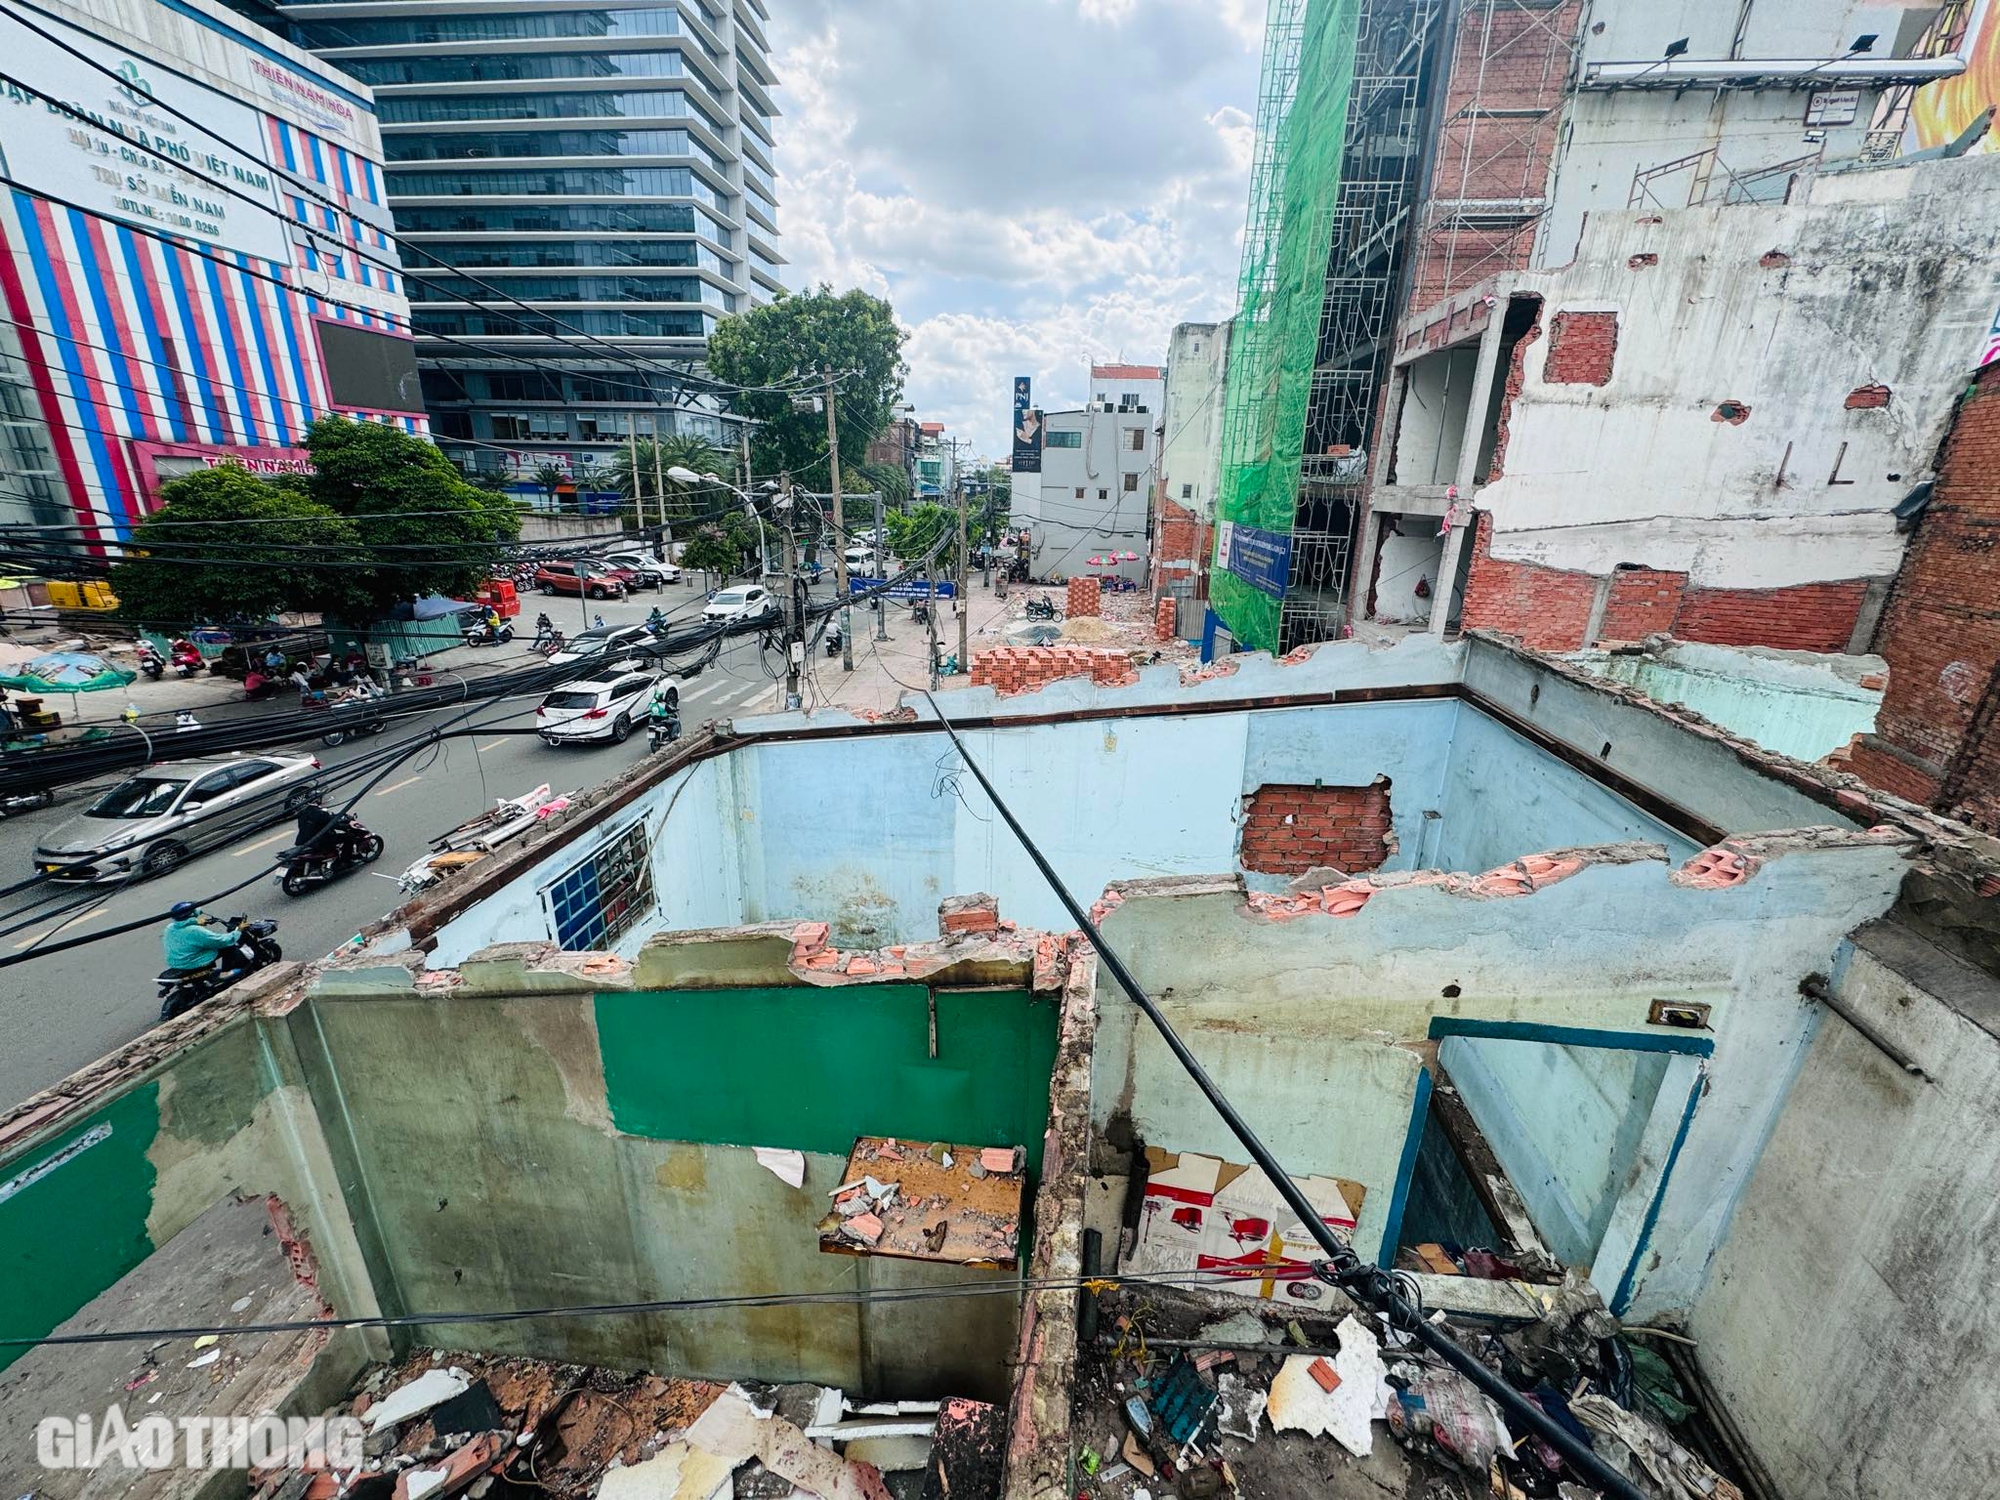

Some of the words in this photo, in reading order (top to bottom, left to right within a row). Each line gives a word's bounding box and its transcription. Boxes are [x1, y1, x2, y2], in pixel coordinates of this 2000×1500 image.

[294, 80, 326, 106] NAM
[154, 136, 191, 162] PHỐ
[232, 164, 270, 191] NAM
[192, 197, 226, 220] NAM
